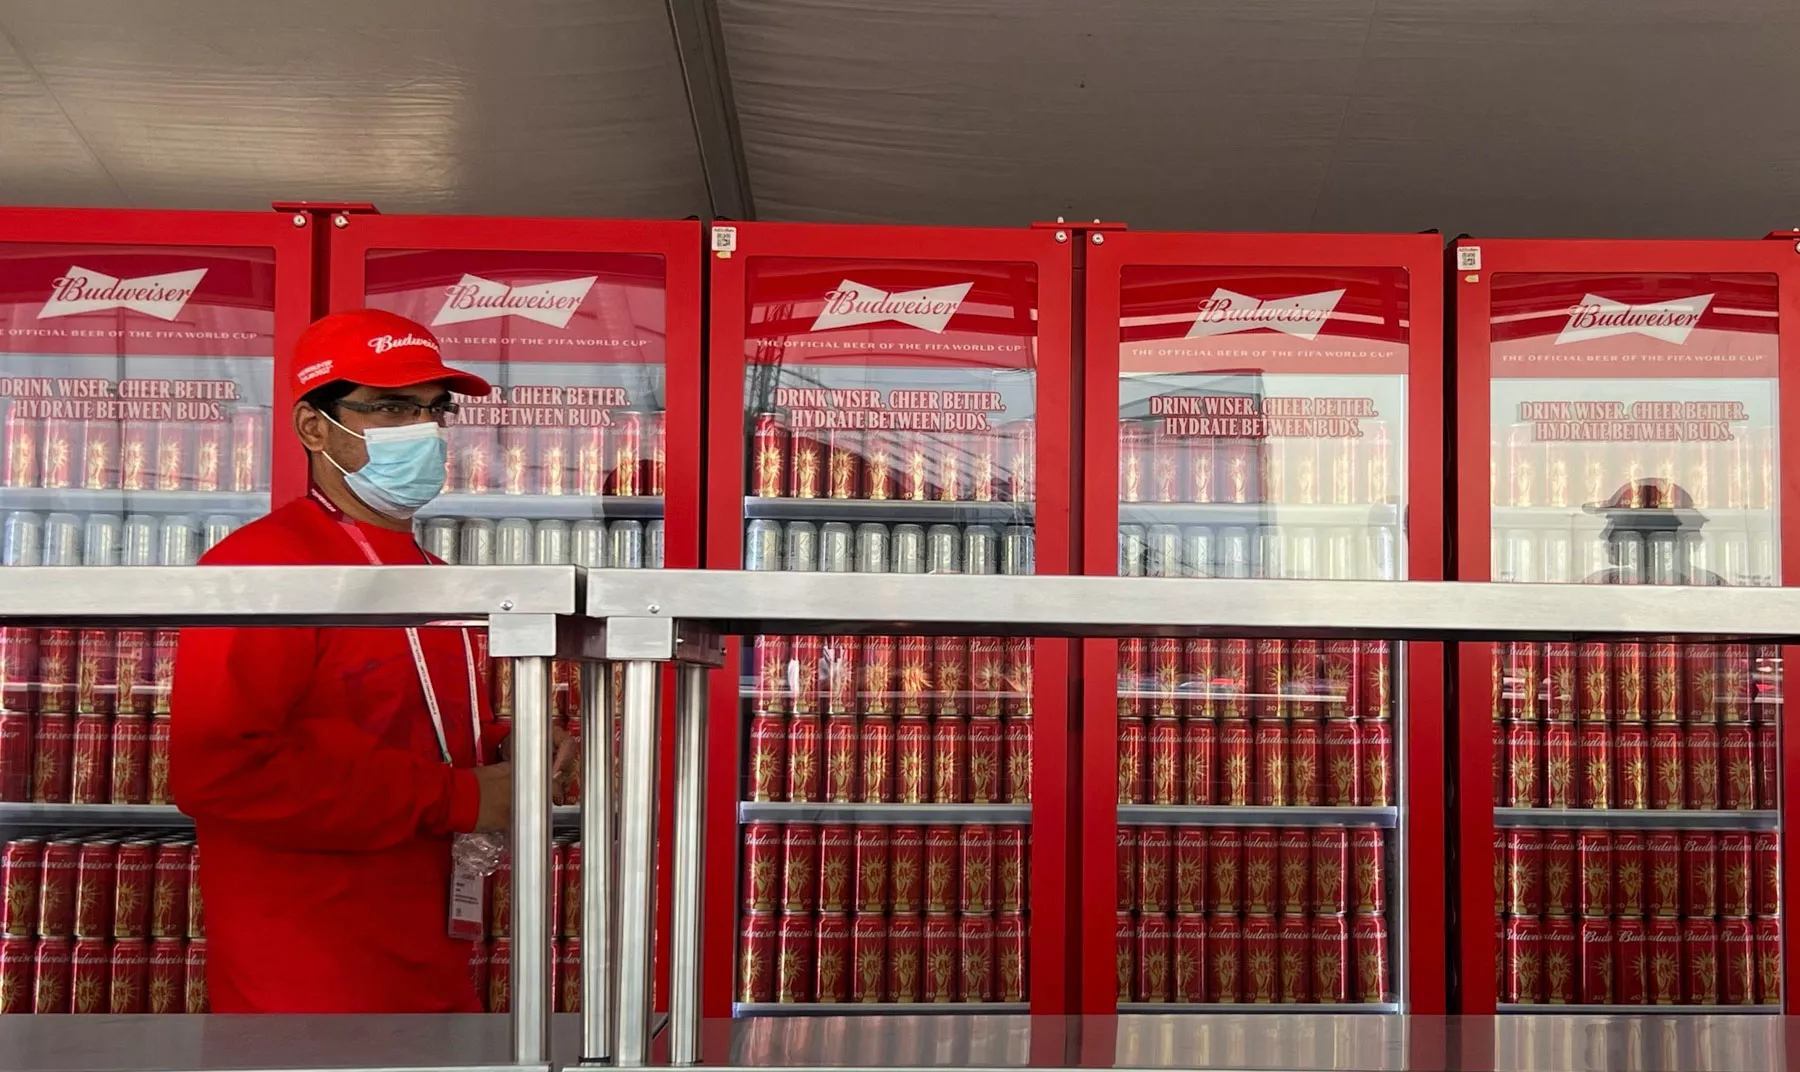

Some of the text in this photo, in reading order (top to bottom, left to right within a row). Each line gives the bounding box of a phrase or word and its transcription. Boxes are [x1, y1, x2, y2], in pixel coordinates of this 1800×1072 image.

[52, 276, 193, 302] Budweiser
[445, 284, 583, 310] Budweiser
[824, 290, 959, 315] Budweiser
[1198, 298, 1332, 323] Budweiser
[1568, 303, 1700, 328] Budweiser
[9, 329, 68, 337] OFFICIAL
[71, 330, 105, 338] BEER
[108, 330, 125, 338] OF
[129, 330, 153, 339] THE
[156, 331, 184, 339] FIFA
[184, 332, 229, 340] WORLD
[232, 332, 258, 341] CUP
[464, 337, 497, 345] BEER
[501, 337, 515, 345] OF
[520, 338, 544, 346] THE
[576, 339, 620, 347] WORLD
[622, 340, 647, 348] CUP
[756, 340, 780, 348] THE
[783, 340, 840, 349] OFFICIAL
[844, 342, 875, 350] BEER
[880, 342, 895, 350] OF
[899, 343, 921, 351] THE
[952, 344, 995, 352] WORLD
[998, 345, 1021, 353] CUP
[1132, 348, 1393, 359] THE OFFICIAL BEER OF THE FIFA WORLD CUP
[1502, 354, 1763, 362] THE OFFICIAL BEER OF THE FIFA WORLD CUP
[1, 377, 240, 401] DRINK WISER. CHEER BETTER.
[511, 387, 562, 406] CHEER
[566, 388, 632, 407] BETTER.
[776, 388, 1006, 411] DRINK WISER. CHEER BETTER.
[15, 400, 224, 422] HYDRATE BETWEEN BUDS.
[490, 407, 565, 426] BETWEEN
[569, 408, 616, 427] BUDS.
[1150, 396, 1378, 417] DRINK WISER. CHEER BETTER.
[1520, 401, 1749, 422] DRINK WISER. CHEER BETTER.
[791, 410, 991, 431] HYDRATE BETWEEN BUDS.
[1165, 416, 1364, 438] HYDRATE BETWEEN BUDS.
[1535, 421, 1734, 443] HYDRATE BETWEEN BUDS.
